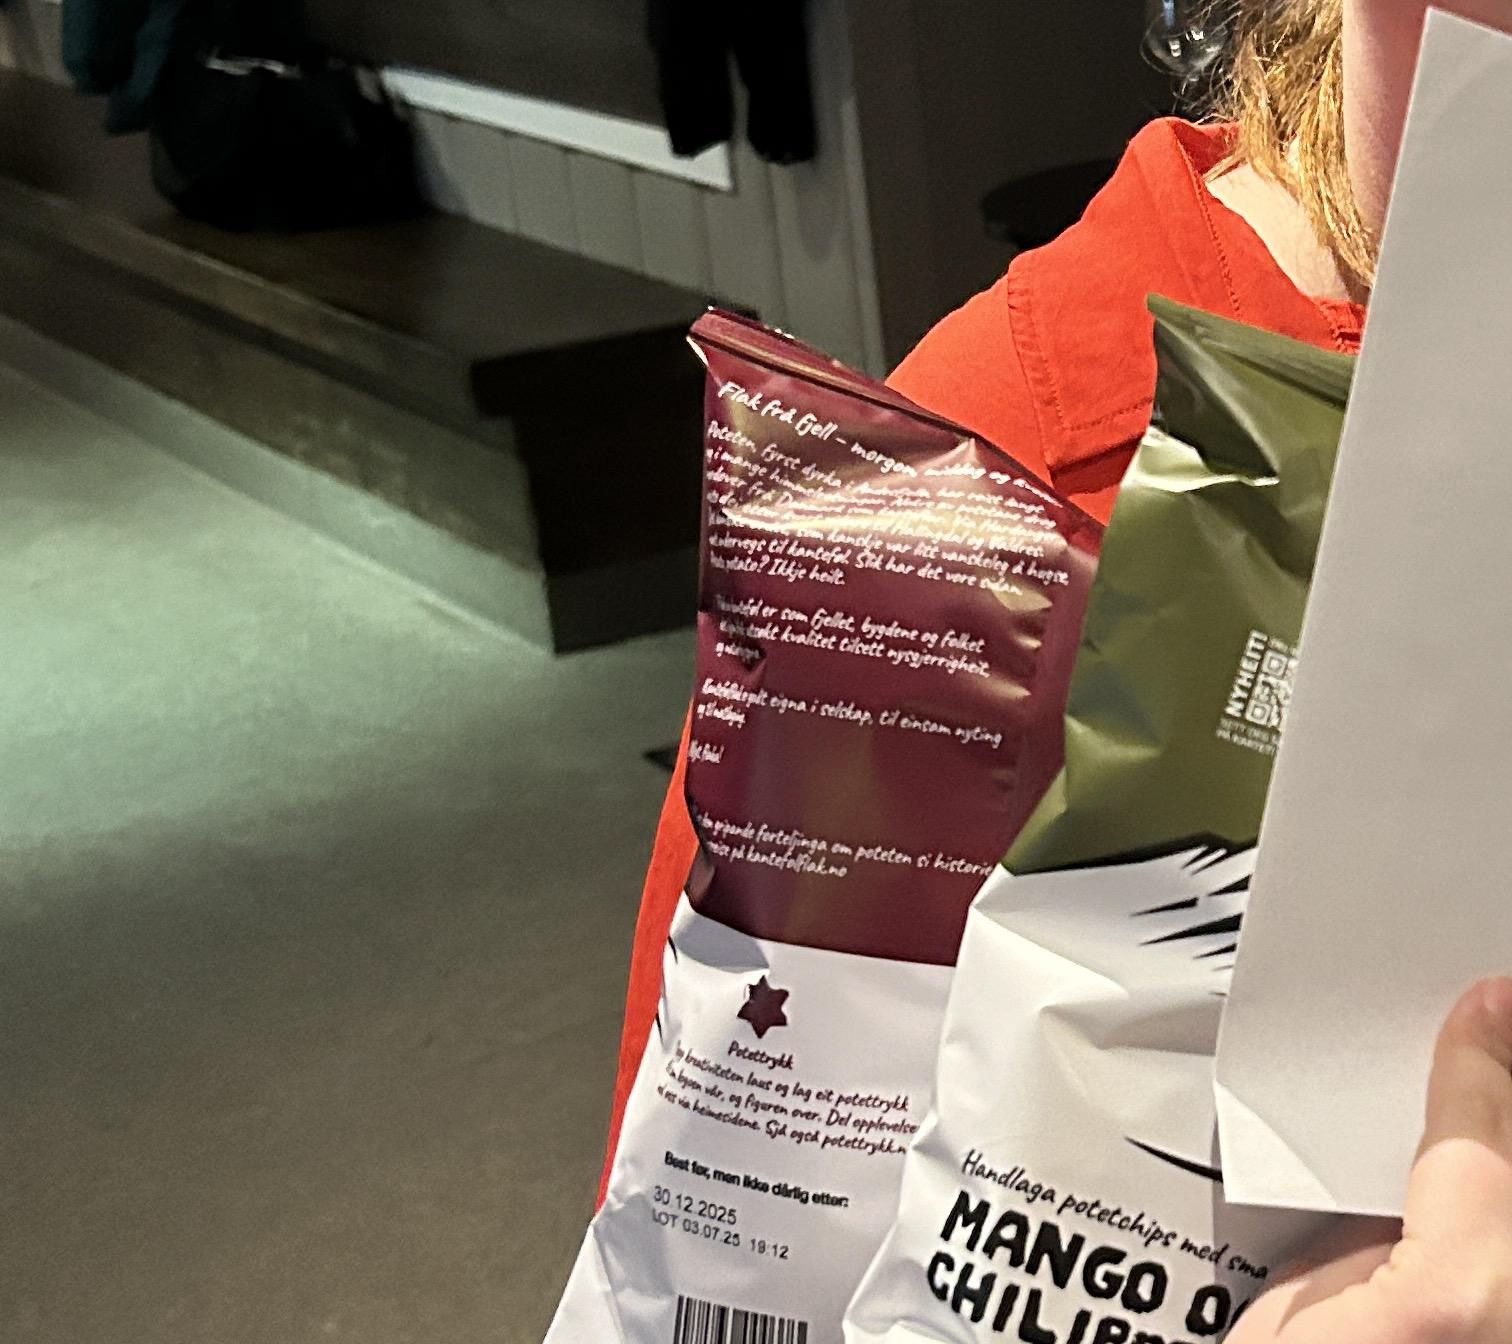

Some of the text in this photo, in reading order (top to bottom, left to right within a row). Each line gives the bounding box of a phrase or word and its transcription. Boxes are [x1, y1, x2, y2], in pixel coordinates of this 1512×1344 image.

[718, 381, 763, 410] Flak
[795, 413, 838, 440] fjell
[768, 539, 789, 554] til
[885, 556, 915, 575] har
[917, 562, 943, 581] det
[768, 558, 807, 583] Ikkje
[781, 607, 808, 623] som
[861, 616, 919, 640] bygdene
[921, 631, 939, 648] og
[941, 628, 986, 653] folket
[781, 625, 838, 650] kvalitet
[770, 693, 807, 714] eigna
[879, 710, 901, 726] til
[900, 714, 952, 735] einsam
[955, 727, 1003, 749] nyting
[831, 843, 853, 855] om
[854, 845, 912, 865] poteten
[917, 853, 932, 868] si
[728, 1040, 793, 1070] Potettrykk
[729, 1094, 742, 1108] og
[744, 1093, 788, 1115] figuren
[791, 1108, 823, 1122] over.
[825, 1108, 852, 1127] Del
[852, 1116, 920, 1134] opplevelse
[775, 1083, 789, 1098] og
[792, 1082, 812, 1102] lag
[815, 1089, 834, 1103] eit
[835, 1093, 909, 1114] potettrykk
[821, 1134, 908, 1157] potettrykk.n
[664, 1151, 691, 1172] Best
[712, 1168, 741, 1187] men
[742, 1173, 770, 1194] ikke
[771, 1182, 809, 1205] dårlig
[811, 1192, 850, 1208] etter:
[652, 1207, 679, 1228] LOT
[961, 1149, 1268, 1280] Handlaga potetchips med sma
[940, 1190, 1252, 1337] MANGO O
